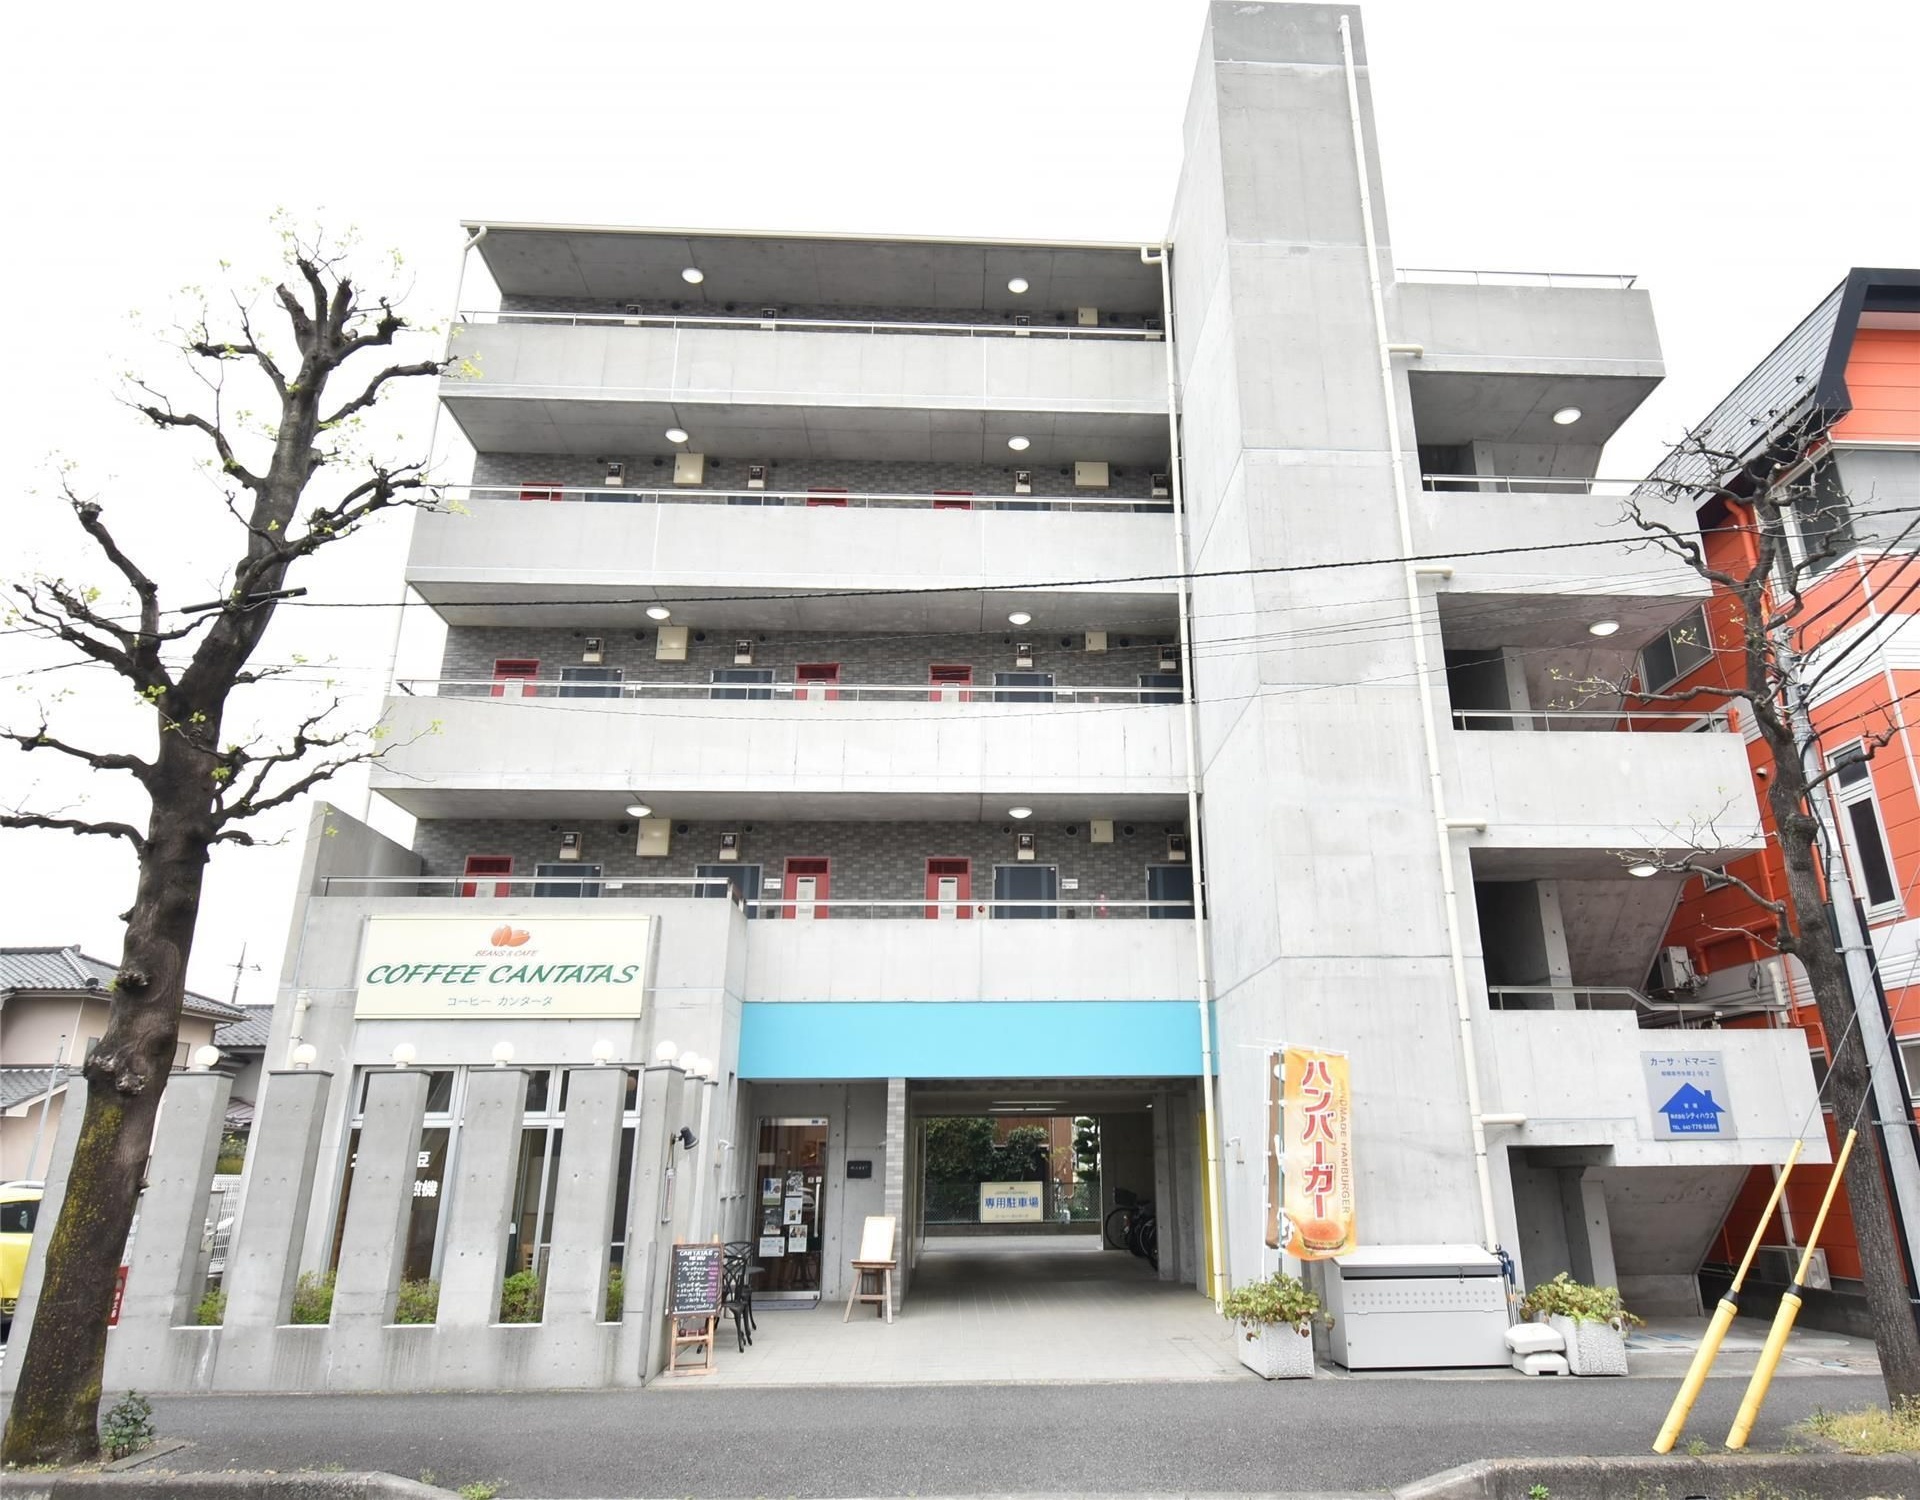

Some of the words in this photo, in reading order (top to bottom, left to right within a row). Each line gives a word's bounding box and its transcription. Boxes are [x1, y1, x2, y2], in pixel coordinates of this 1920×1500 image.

[474, 949, 506, 957] BEANS
[366, 964, 487, 984] COFFEE
[488, 964, 639, 984] CANTATAS
[447, 996, 491, 1007] コーヒー
[498, 995, 553, 1007] カンタータ
[1302, 1061, 1335, 1219] ハンバーガー
[1342, 1143, 1351, 1214] HAMBURGER
[985, 1196, 1039, 1209] 専用駐車場
